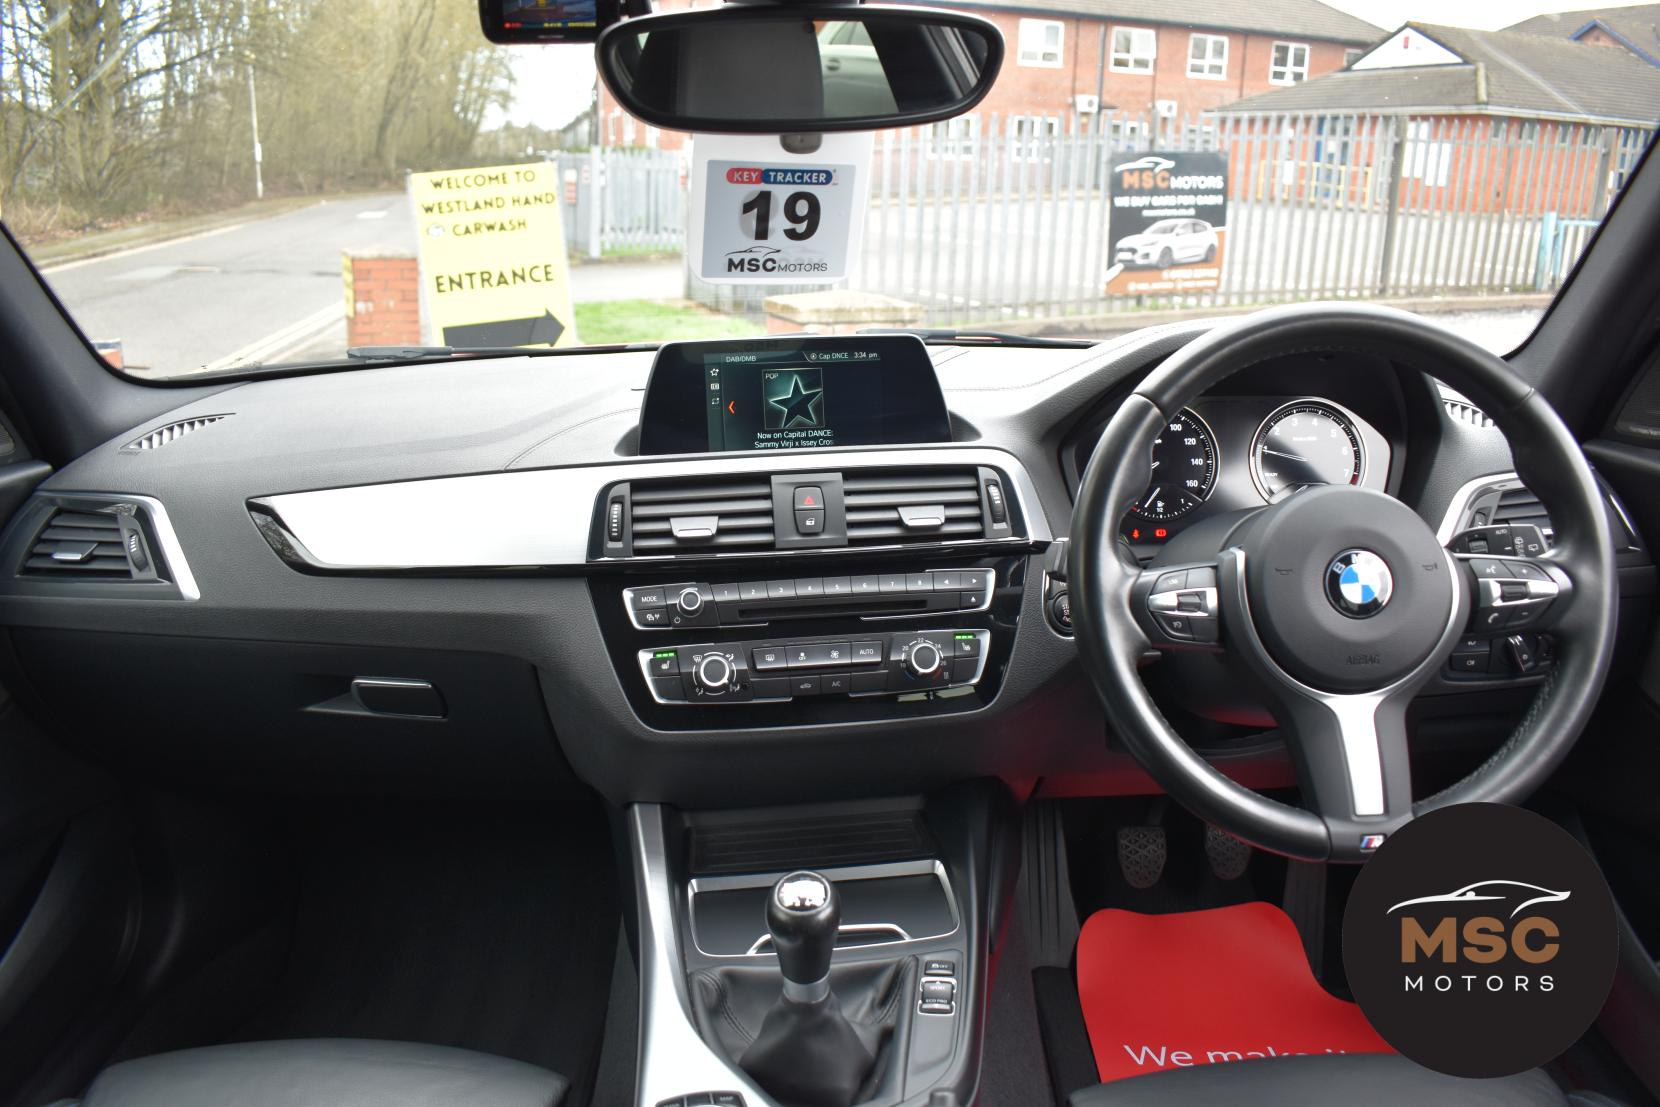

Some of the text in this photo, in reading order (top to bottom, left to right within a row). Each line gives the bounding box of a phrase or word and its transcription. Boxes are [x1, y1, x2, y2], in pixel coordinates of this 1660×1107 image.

[430, 170, 536, 190] WELCOME TO
[733, 171, 760, 182] KEY
[769, 172, 827, 184] TRACKER
[1122, 170, 1170, 190] MSC
[421, 192, 556, 214] WESTLAND HAND
[742, 190, 822, 242] 19
[452, 219, 528, 237] CARWASH
[727, 257, 828, 273] MSC MOTORS
[435, 264, 555, 294] ENTRANCE
[726, 355, 757, 363] DAB/DMB
[765, 372, 779, 380] POP
[1169, 423, 1182, 431] 100
[1292, 417, 1298, 427] 3
[1312, 417, 1318, 427] 4
[783, 430, 807, 439] Capital
[1274, 426, 1280, 436] 2
[1330, 429, 1337, 438] 5
[780, 440, 794, 448] Virji
[800, 439, 817, 447] Issey
[1184, 437, 1197, 445] 120
[1341, 446, 1348, 456] 6
[1191, 458, 1203, 466] 140
[1343, 468, 1350, 478] 7
[1123, 1044, 1194, 1067] We
